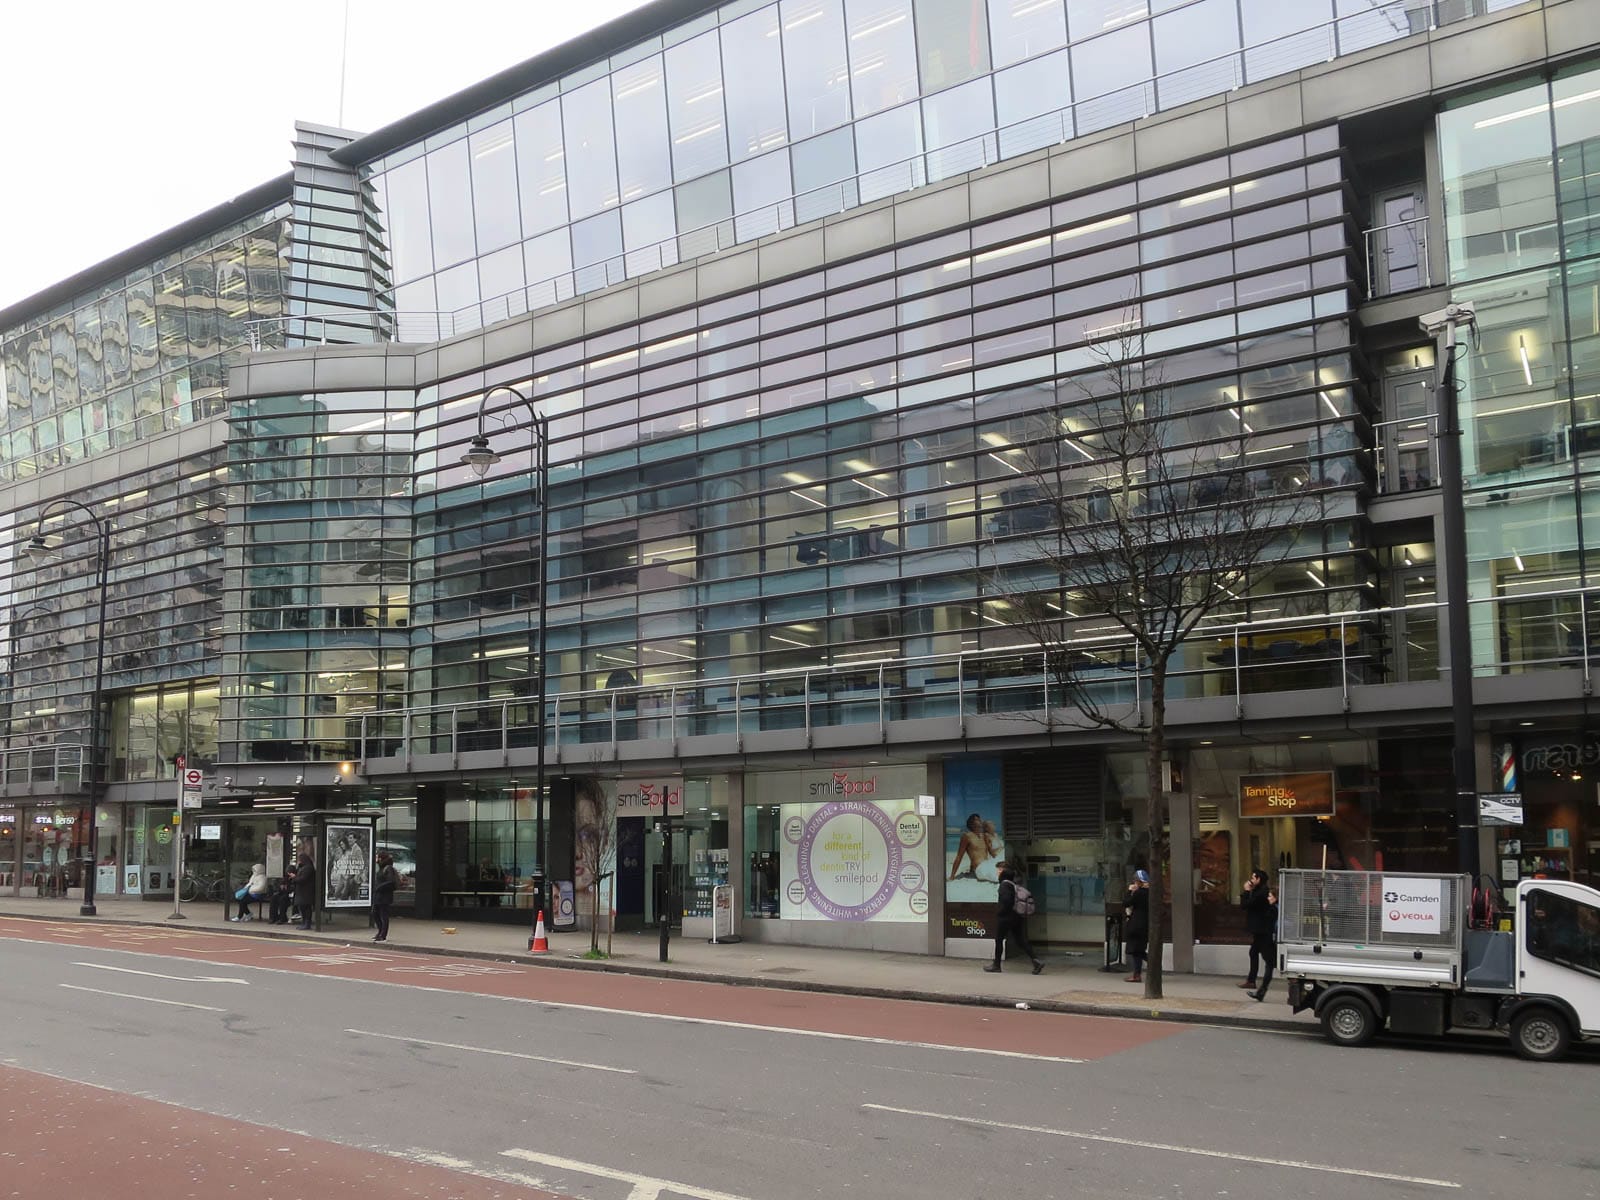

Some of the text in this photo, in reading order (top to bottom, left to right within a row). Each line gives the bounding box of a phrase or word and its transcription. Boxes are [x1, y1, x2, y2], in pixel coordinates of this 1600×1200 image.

[809, 775, 876, 799] smilepod
[1244, 785, 1285, 798] Tanning
[1268, 795, 1296, 808] Shop
[808, 807, 834, 834] DENTAL
[839, 801, 893, 839] STRAIGHTENING
[900, 822, 920, 830] Dental
[824, 841, 862, 850] different
[800, 841, 811, 885] CLEANING
[888, 847, 898, 887] HYGIENE
[834, 873, 878, 885] smilepod
[811, 891, 852, 918] WHITENING
[859, 894, 886, 915] DENTAL
[1400, 894, 1439, 902] Camden
[951, 918, 978, 928] Tanning
[967, 926, 986, 936] Shop
